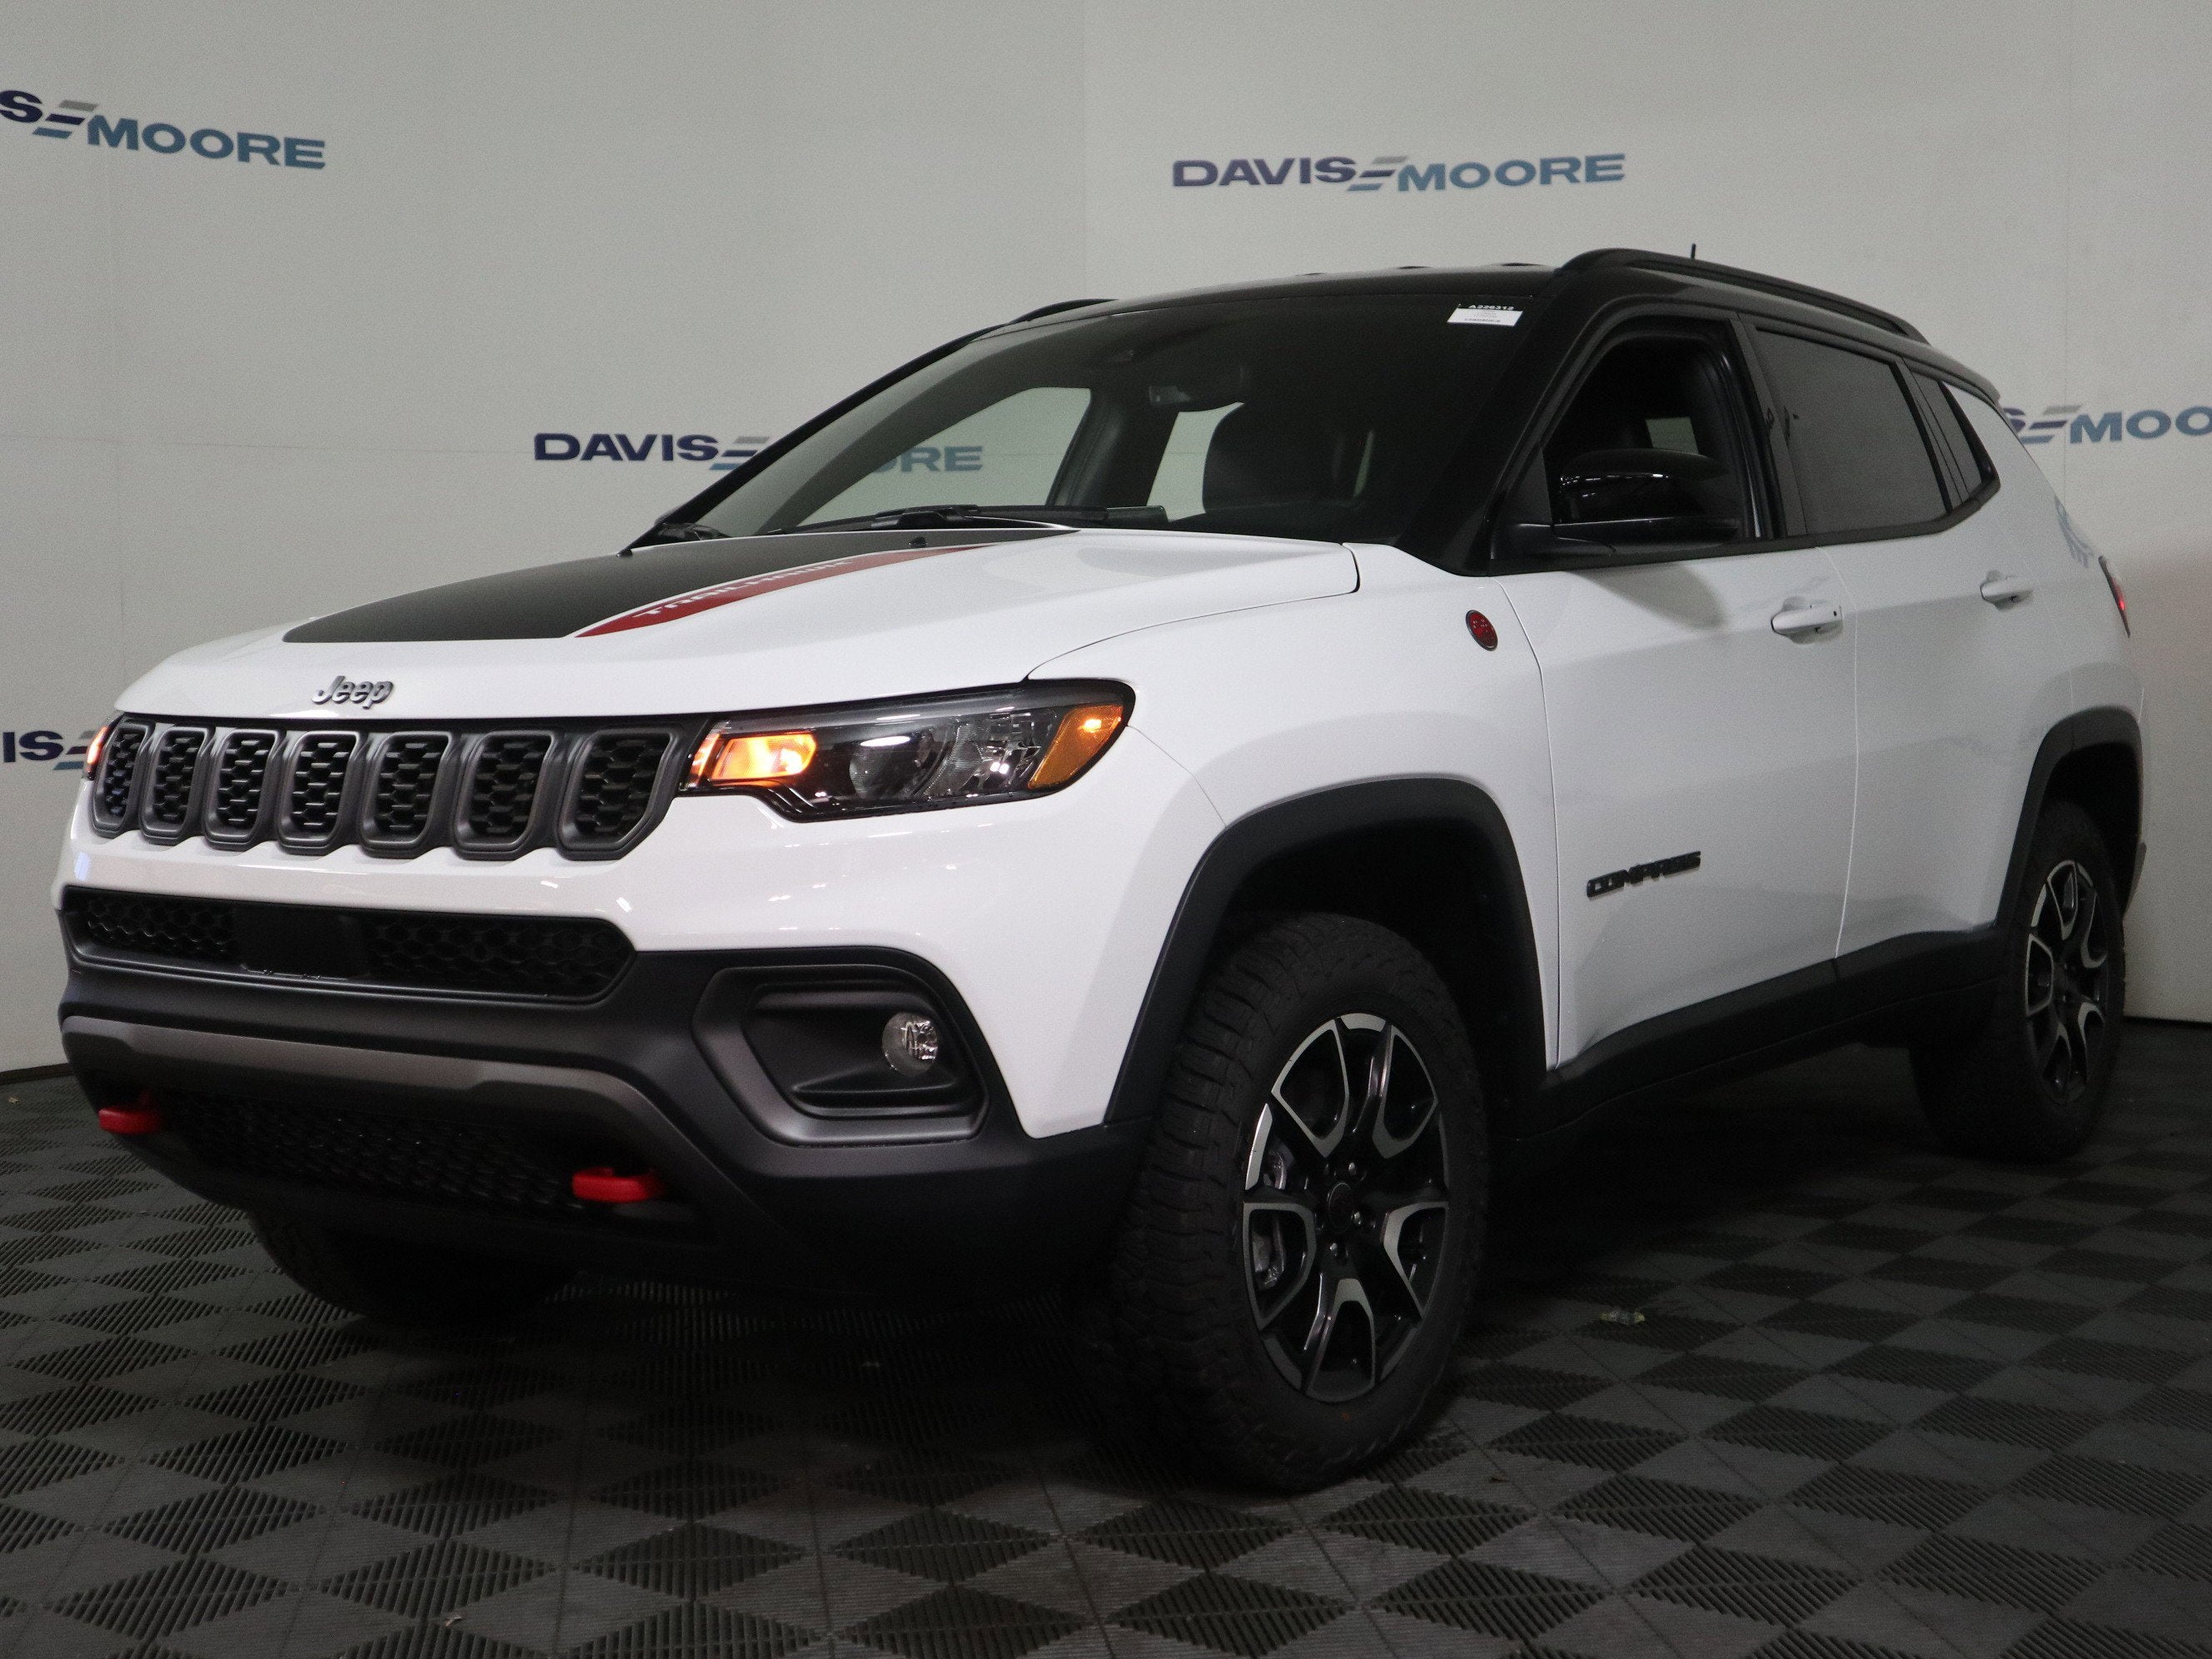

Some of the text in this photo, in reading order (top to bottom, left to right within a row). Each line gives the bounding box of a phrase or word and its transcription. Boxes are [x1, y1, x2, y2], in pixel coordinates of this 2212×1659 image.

[87, 114, 326, 169] MOORE
[1172, 153, 1625, 192] DAVIS MOORE
[2070, 406, 2212, 445] MOO
[534, 433, 984, 472] DAVIS RE
[311, 675, 394, 710] Jeep
[2, 730, 64, 762] IS
